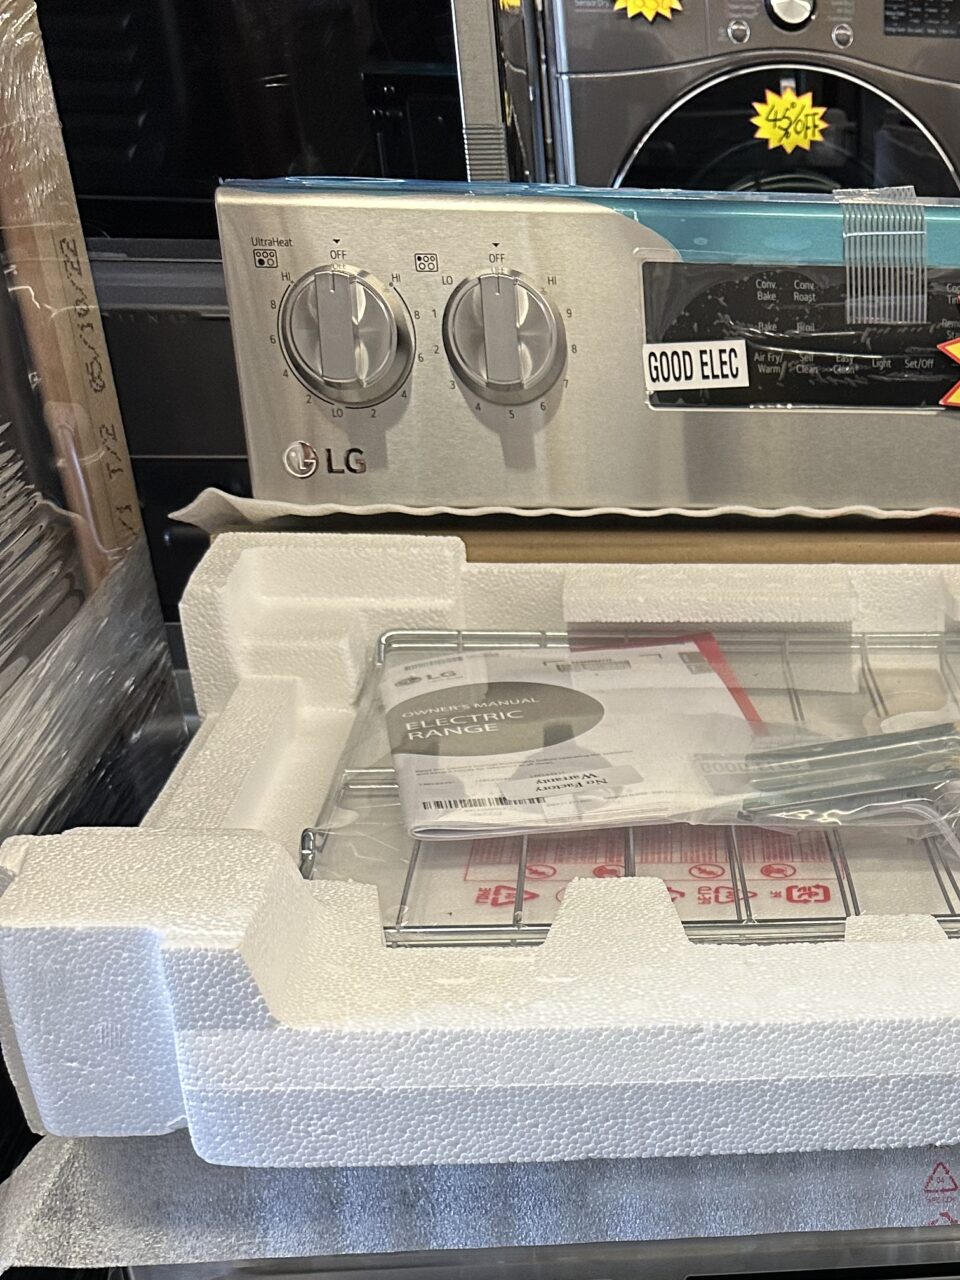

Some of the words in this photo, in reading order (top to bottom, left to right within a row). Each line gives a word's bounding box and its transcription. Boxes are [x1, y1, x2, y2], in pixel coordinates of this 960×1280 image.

[251, 237, 293, 248] UltraHeat
[330, 250, 347, 260] OFF
[489, 254, 505, 263] OFF
[281, 272, 291, 281] HI
[391, 274, 401, 283] HI
[442, 277, 453, 285] LO
[547, 277, 557, 285] HI
[757, 291, 776, 301] Bake
[794, 292, 816, 302] Roast
[271, 301, 277, 309] 8
[414, 311, 420, 320] 8
[432, 309, 437, 318] 1
[566, 309, 572, 318] 9
[270, 335, 276, 344] 6
[434, 345, 440, 353] 2
[571, 345, 578, 353] 8
[418, 354, 424, 362] 6
[753, 352, 766, 361] Air
[767, 352, 783, 363] Fry/
[648, 351, 694, 383] GOOD
[699, 347, 739, 380] ELEC
[872, 359, 892, 370] Light
[904, 358, 934, 369] Set/Off
[283, 369, 289, 378] 4
[758, 365, 780, 373] Warm
[450, 381, 456, 389] 3
[563, 380, 569, 388] 7
[401, 390, 408, 398] 4
[306, 395, 312, 403] 2
[475, 403, 481, 411] 4
[540, 402, 546, 411] 6
[332, 409, 344, 418] LO
[371, 409, 377, 417] 2
[509, 410, 515, 418] 5
[326, 448, 367, 474] LG
[426, 670, 456, 681] LG
[401, 703, 470, 718] OWNER'S
[474, 697, 540, 708] MANUAL
[405, 710, 524, 731] ELECTRIC
[408, 723, 500, 740] RANGE
[536, 772, 599, 785] Warranty
[588, 777, 608, 786] No
[535, 781, 584, 792] Factory
